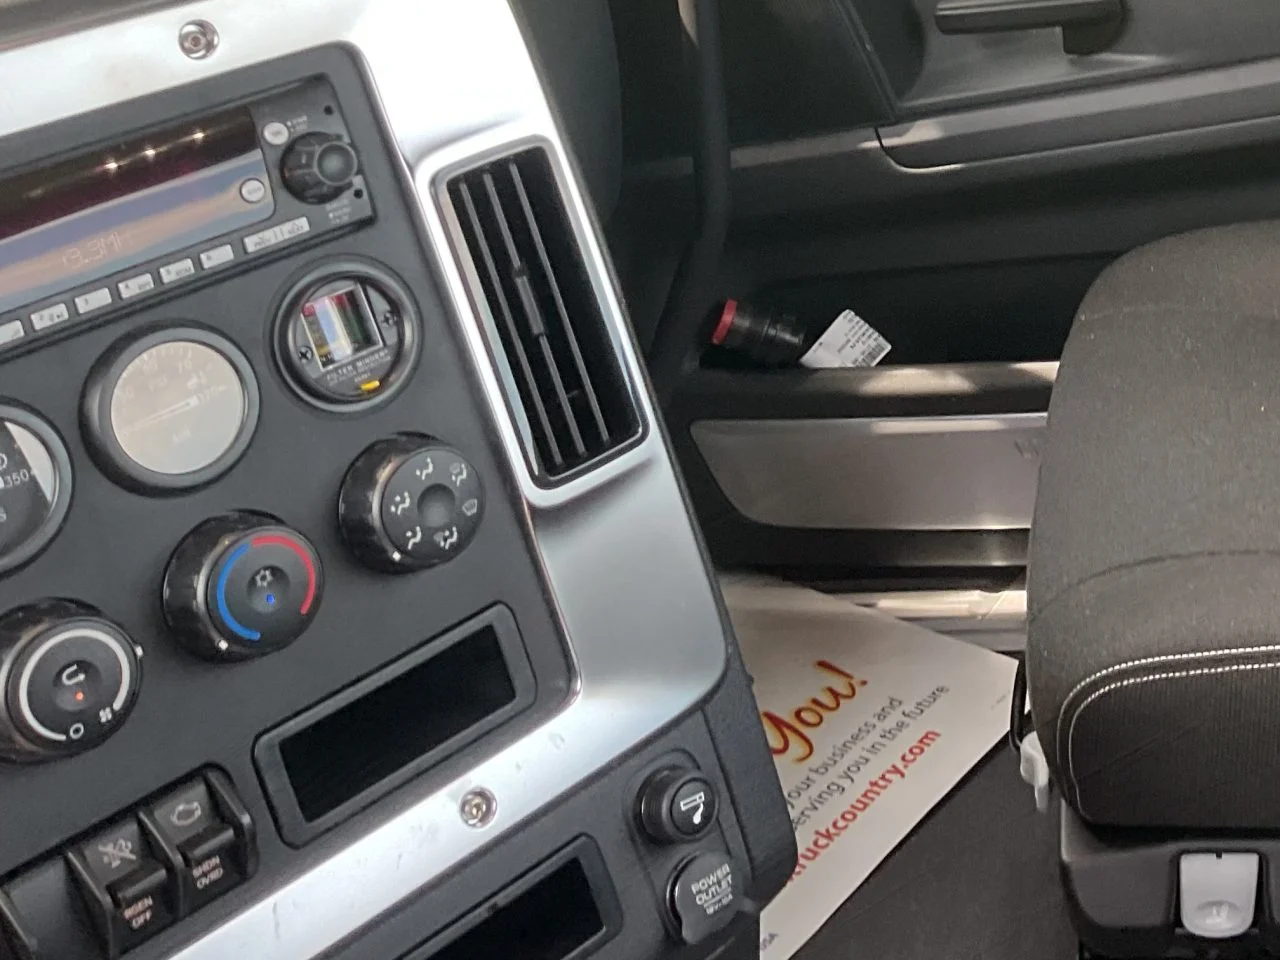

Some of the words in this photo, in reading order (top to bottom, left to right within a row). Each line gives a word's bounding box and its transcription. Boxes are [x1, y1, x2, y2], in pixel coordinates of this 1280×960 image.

[4, 468, 30, 488] 350
[761, 660, 868, 763] You!
[808, 720, 876, 775] business
[873, 695, 903, 723] and
[838, 754, 870, 784] you
[861, 741, 887, 755] in
[880, 720, 910, 741] the
[901, 685, 950, 720] future
[691, 863, 731, 895] POWER
[695, 874, 733, 906] OUTLET
